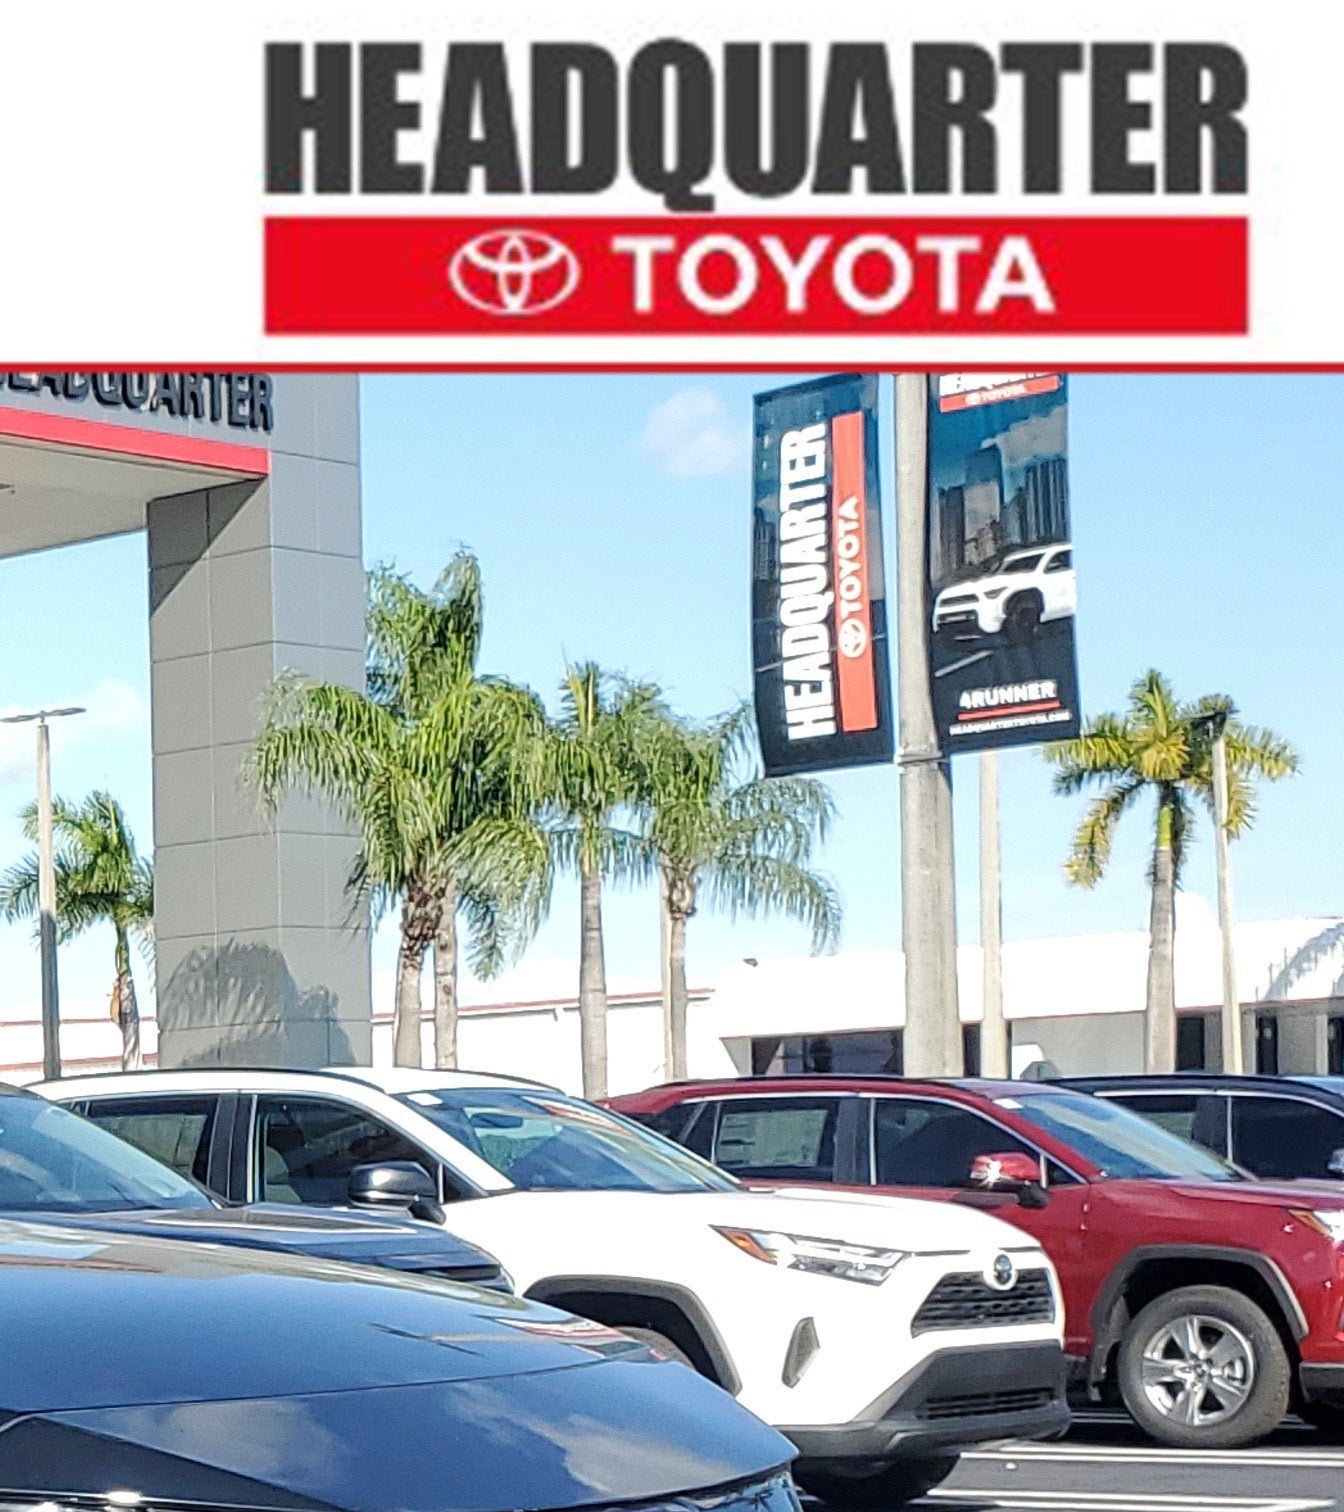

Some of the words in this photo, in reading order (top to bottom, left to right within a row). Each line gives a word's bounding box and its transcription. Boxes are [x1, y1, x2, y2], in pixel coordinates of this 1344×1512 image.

[779, 421, 837, 741] HEADQUARTER
[838, 496, 864, 620] TOYOTA
[958, 679, 1058, 710] 4RUNNER
